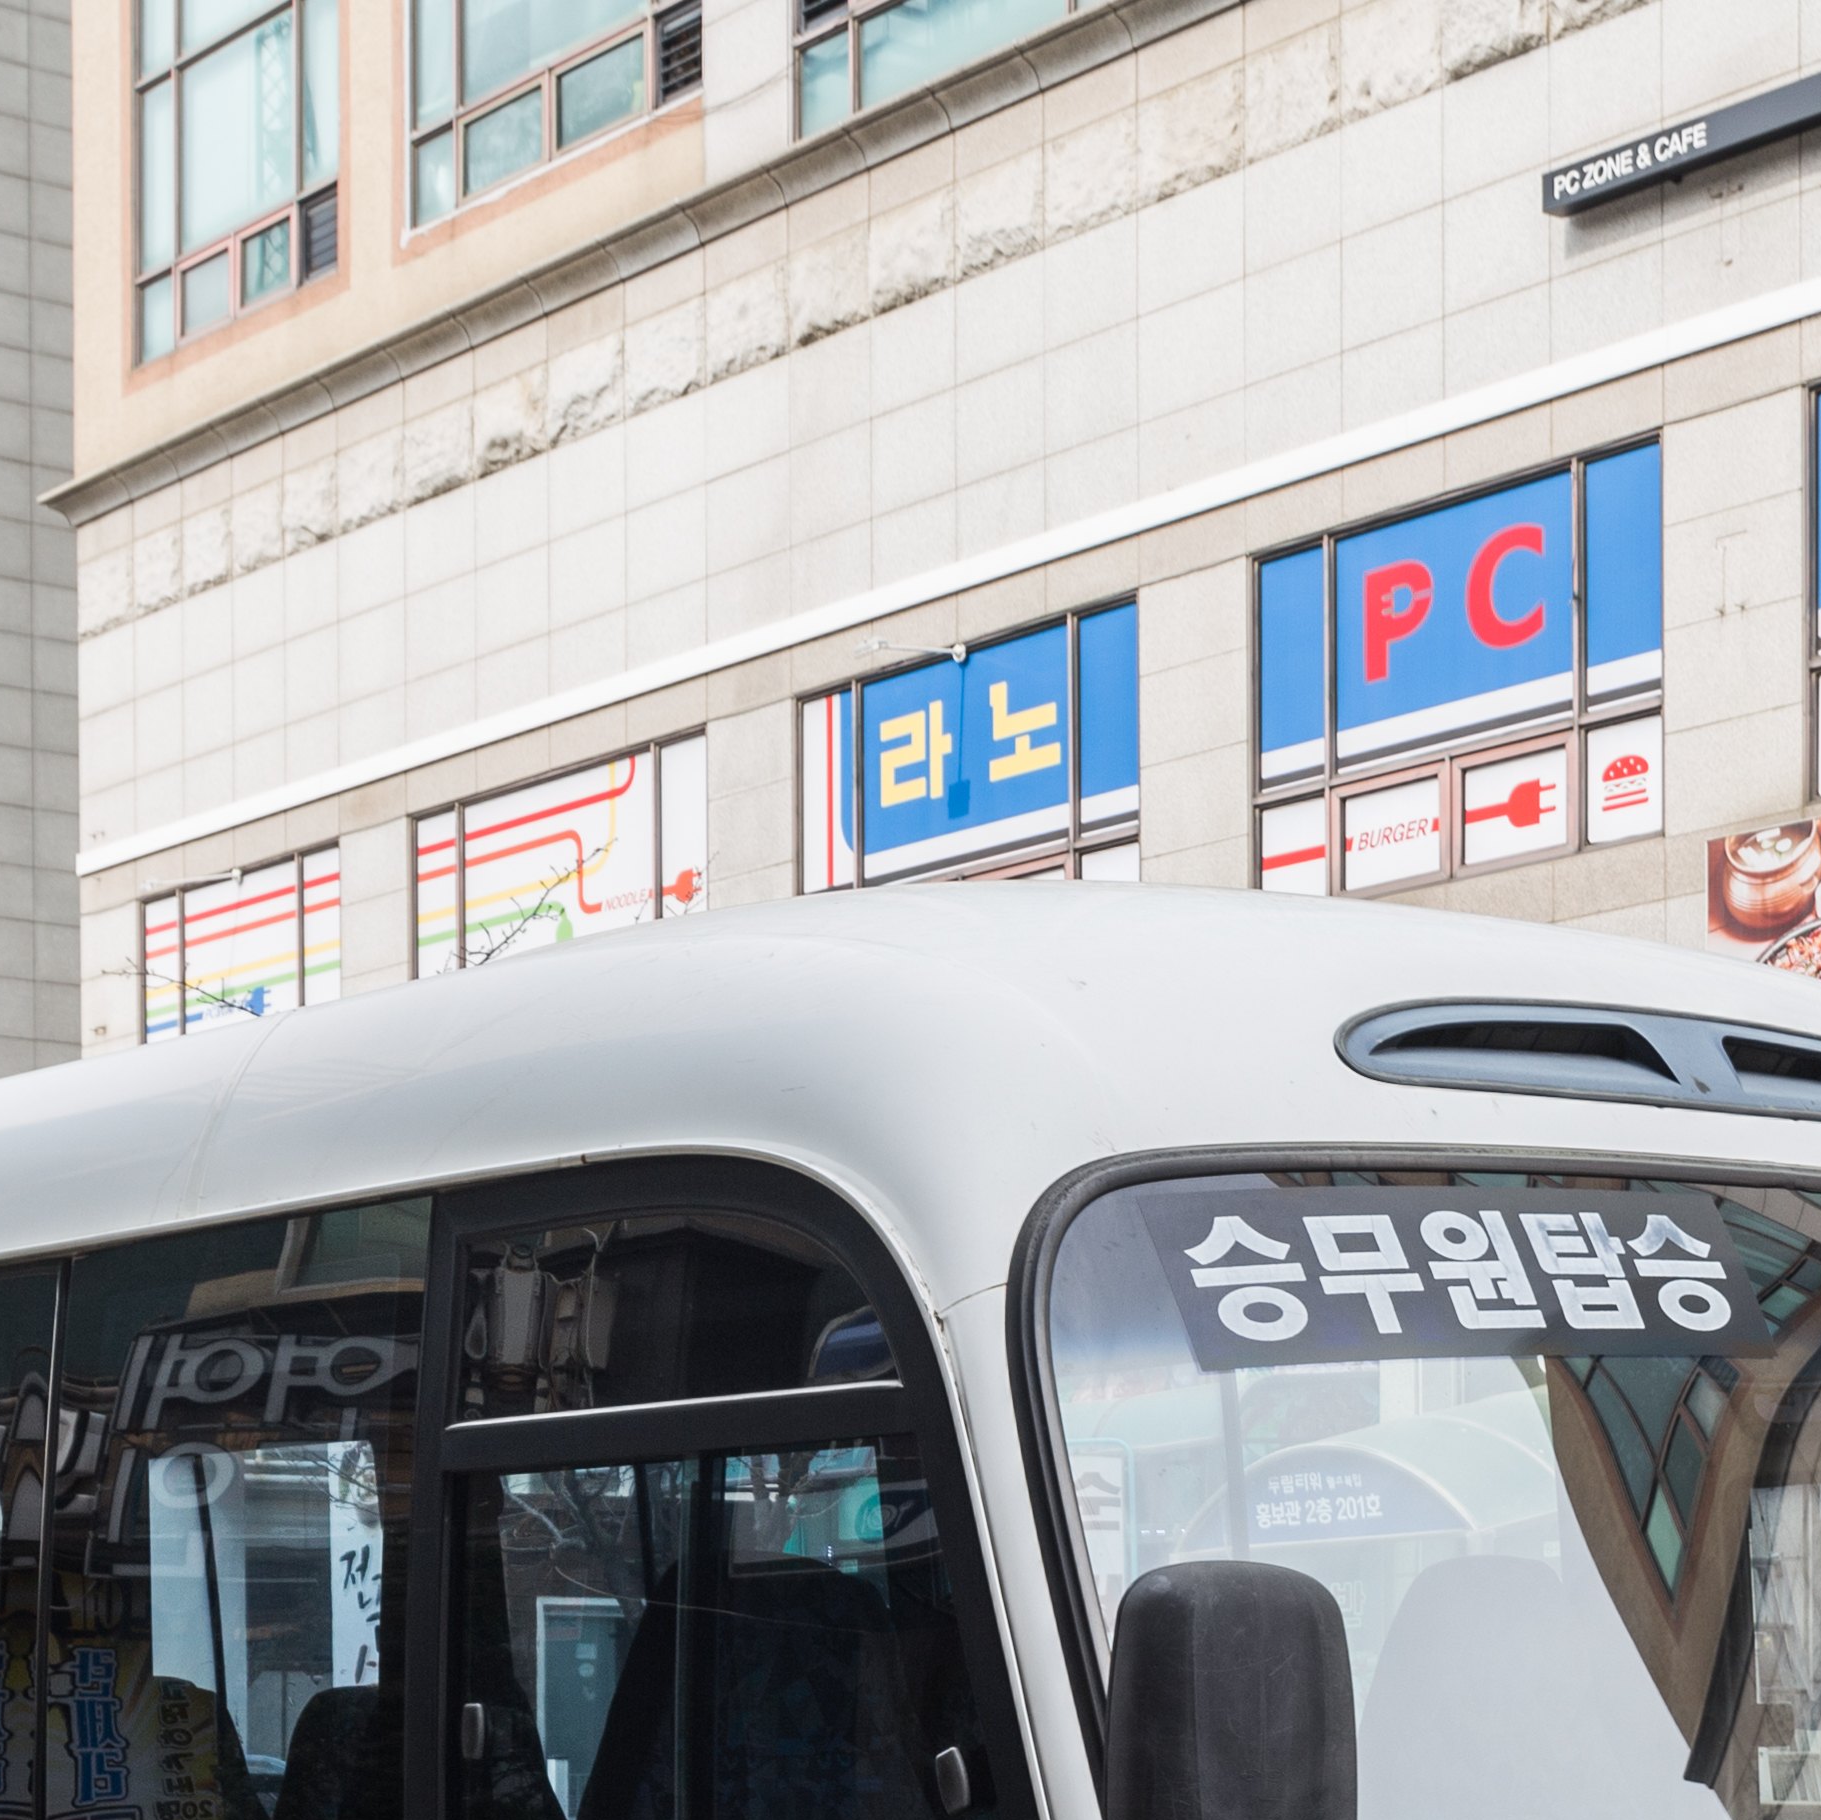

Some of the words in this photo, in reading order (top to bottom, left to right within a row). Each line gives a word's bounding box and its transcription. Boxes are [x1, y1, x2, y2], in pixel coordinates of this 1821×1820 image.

[1553, 168, 1581, 200] PC
[1581, 148, 1634, 191] ZONE
[1636, 140, 1653, 172] &
[1653, 121, 1709, 164] CAFE
[1355, 815, 1430, 854] BURGER
[602, 886, 650, 913] NOODLE
[1182, 1208, 1733, 1343] 승무원탑승
[1255, 1500, 1302, 1529] 홍보관
[1305, 1496, 1333, 1524] 2층
[1335, 1493, 1383, 1520] 201호
